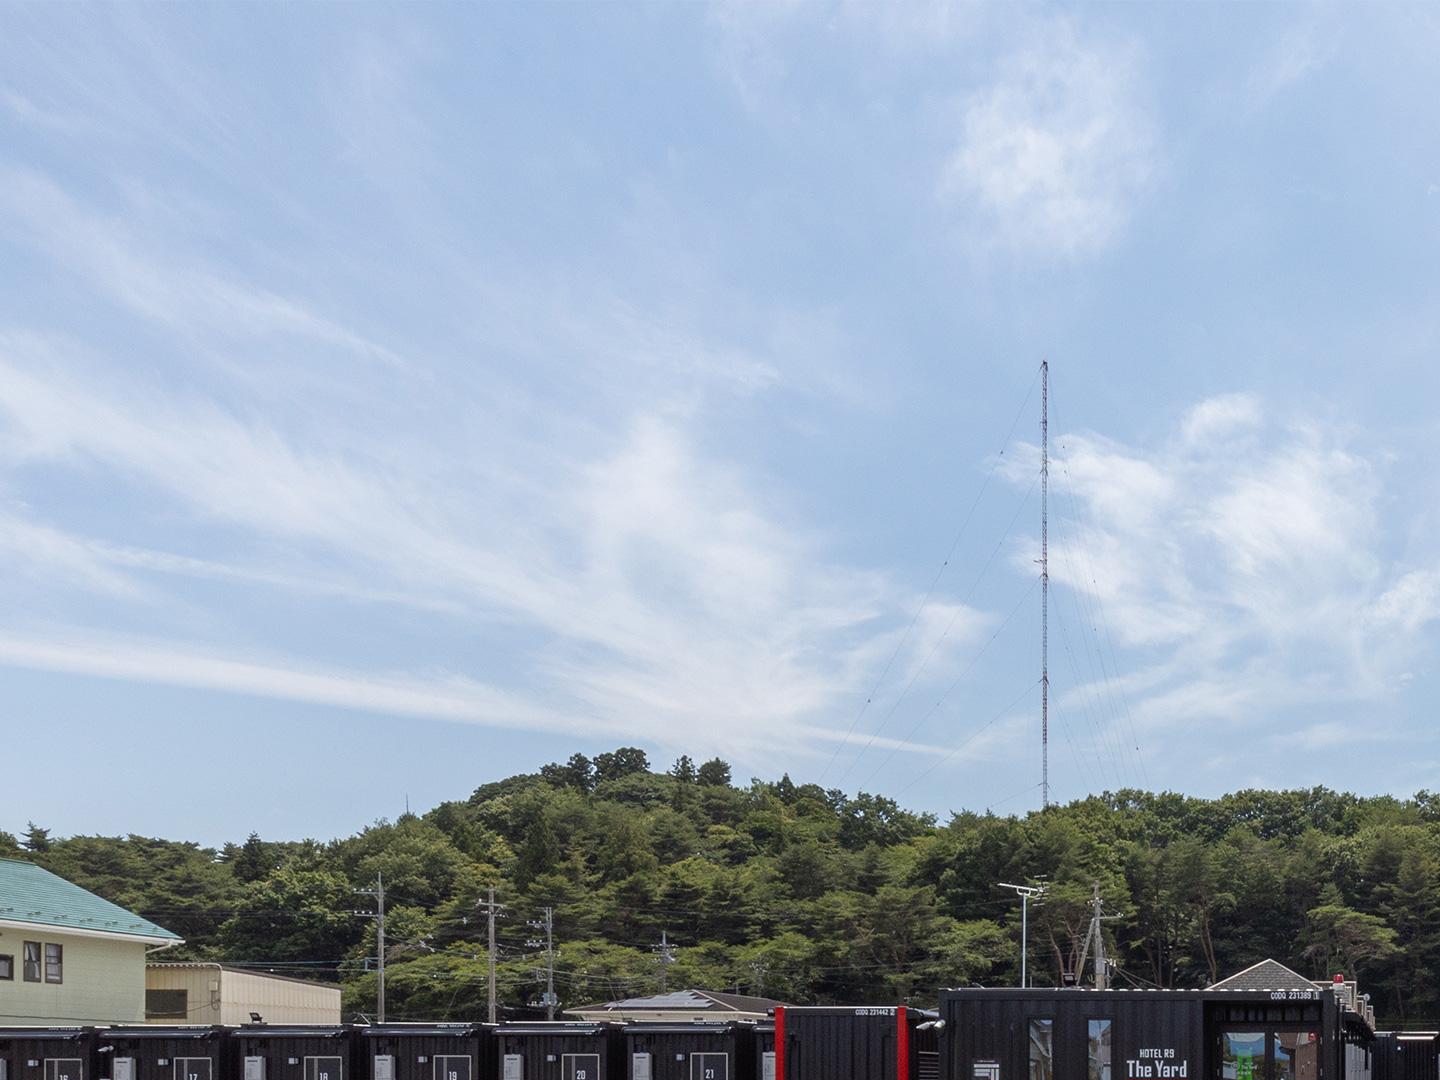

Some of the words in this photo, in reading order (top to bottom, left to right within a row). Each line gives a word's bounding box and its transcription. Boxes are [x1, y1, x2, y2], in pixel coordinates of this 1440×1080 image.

[1288, 992, 1312, 1000] 231389
[1139, 1049, 1162, 1058] HOTEL
[1164, 1049, 1175, 1058] R9
[705, 1069, 714, 1079] 21
[1126, 1060, 1152, 1078] The
[1154, 1060, 1187, 1078] Yard
[576, 1070, 586, 1080] 20
